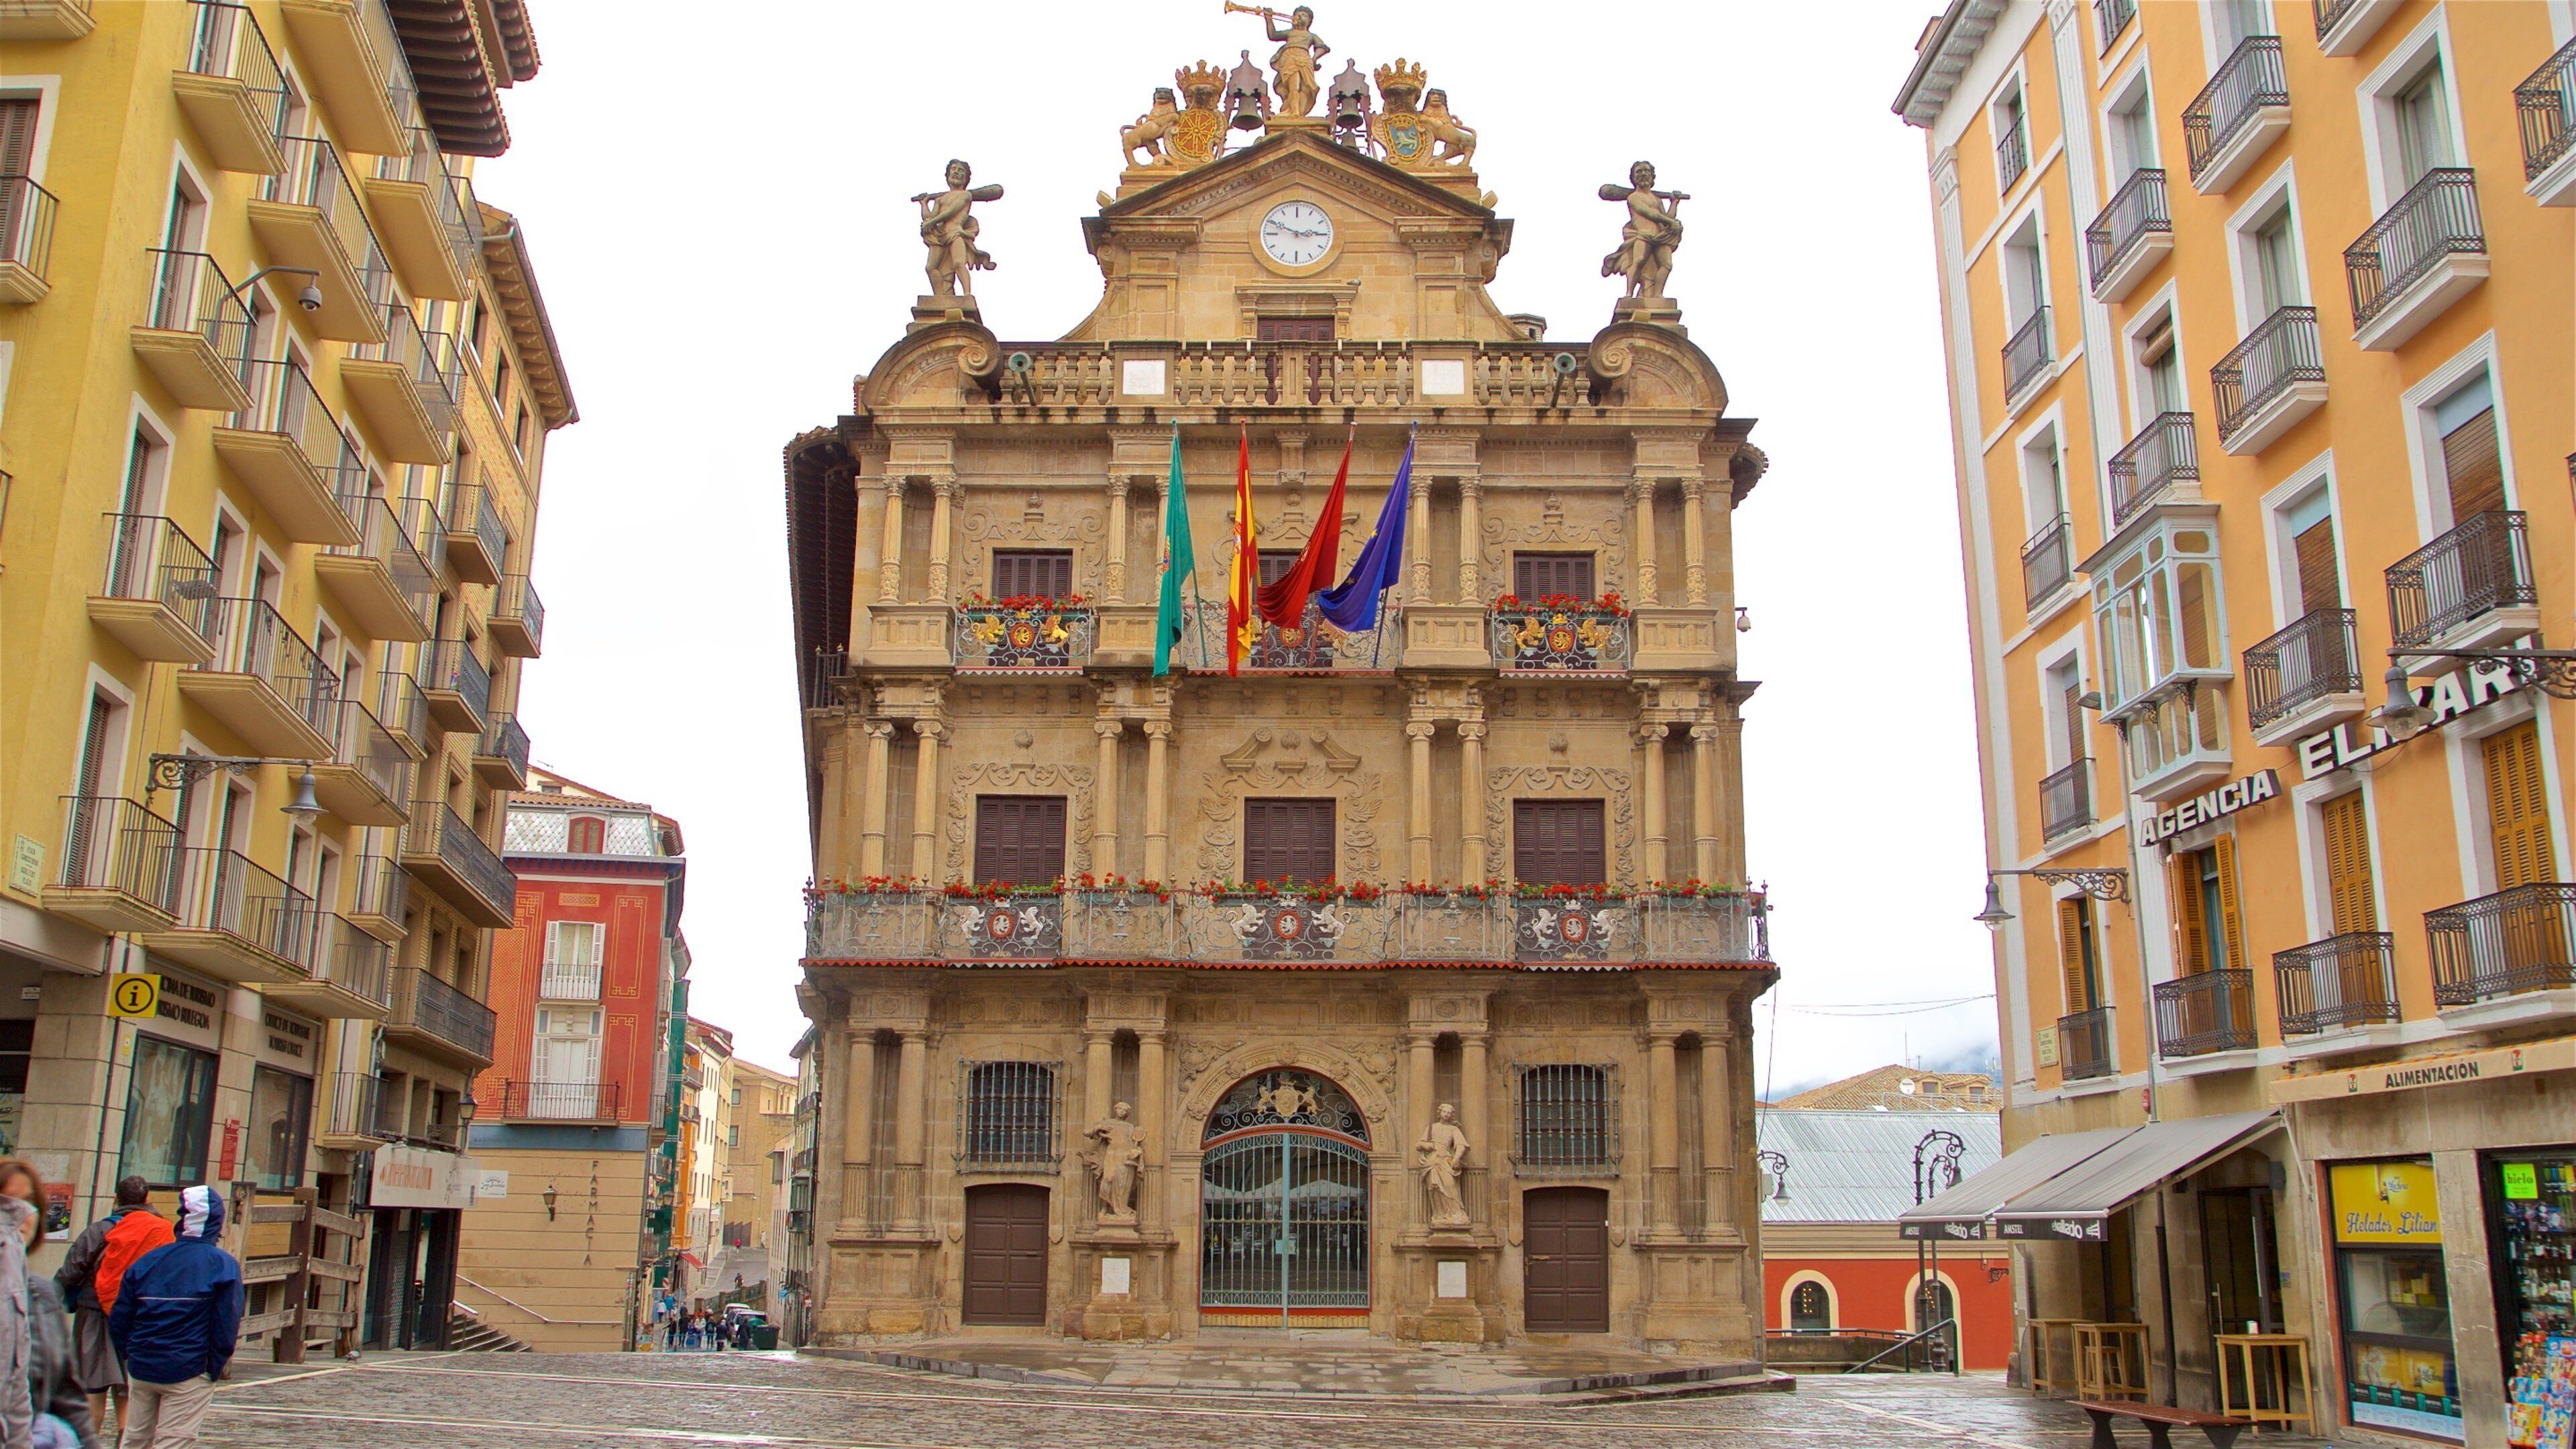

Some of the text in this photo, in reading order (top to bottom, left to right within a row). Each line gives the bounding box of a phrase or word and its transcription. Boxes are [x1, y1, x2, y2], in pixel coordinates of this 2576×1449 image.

[2141, 769, 2277, 847] AGENCIA
[2385, 1059, 2479, 1088] ALIMENTACIÓN
[2506, 1173, 2534, 1184] hielo
[584, 1161, 599, 1267] FARMACIA
[2346, 1212, 2438, 1234] Helados Lilian
[2004, 1224, 2023, 1234] AMSTEL
